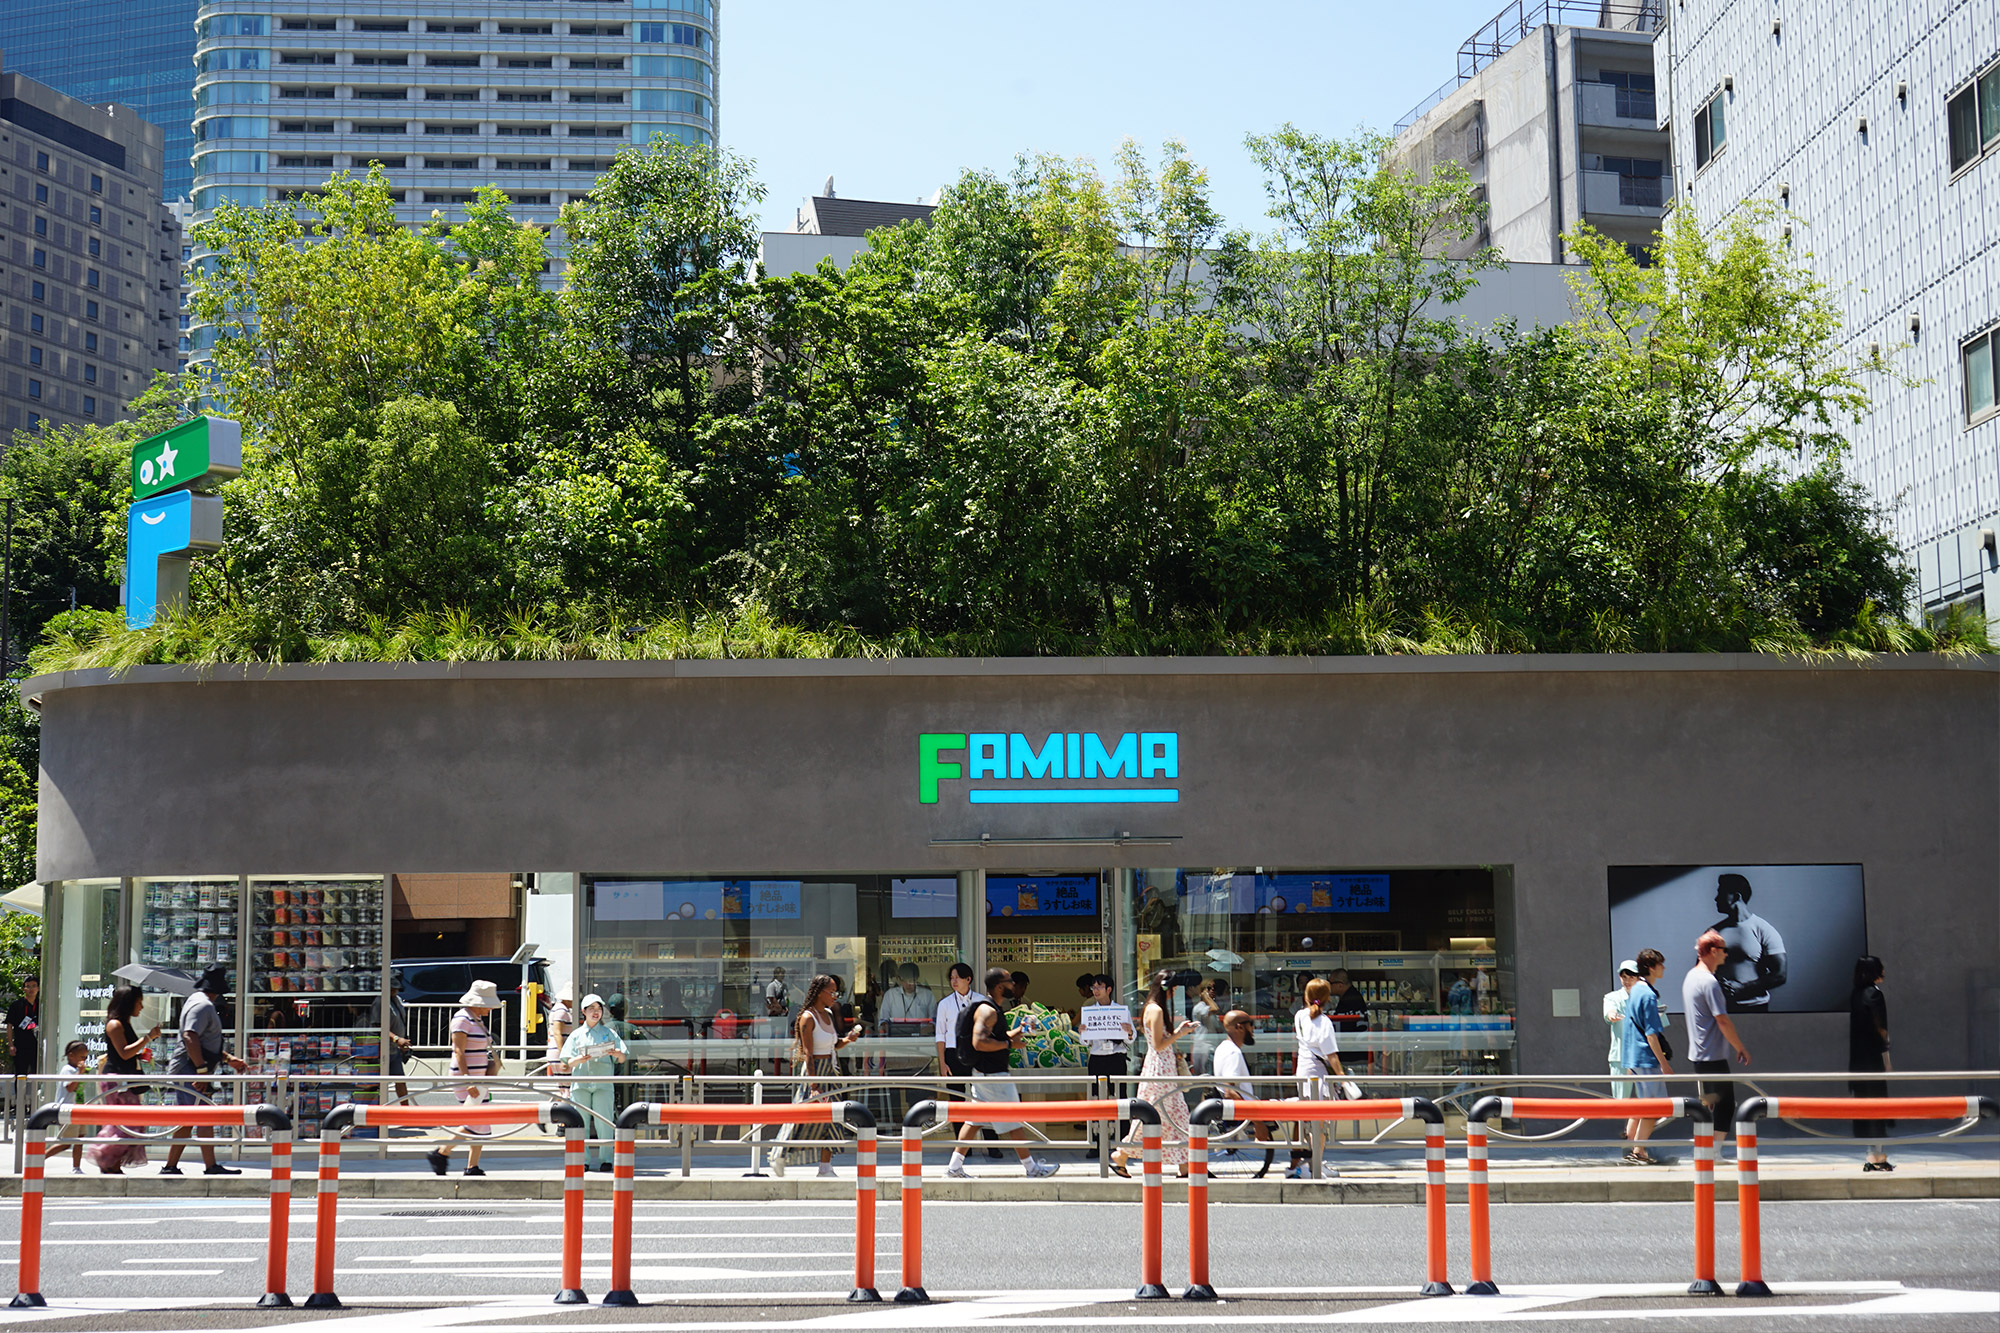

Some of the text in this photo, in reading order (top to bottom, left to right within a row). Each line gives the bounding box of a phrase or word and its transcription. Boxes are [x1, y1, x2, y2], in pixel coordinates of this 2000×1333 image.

[919, 732, 1180, 804] FAMIMA
[760, 889, 783, 902] 絶品
[1056, 886, 1079, 899] 絶品
[1043, 898, 1094, 911] うすしお味
